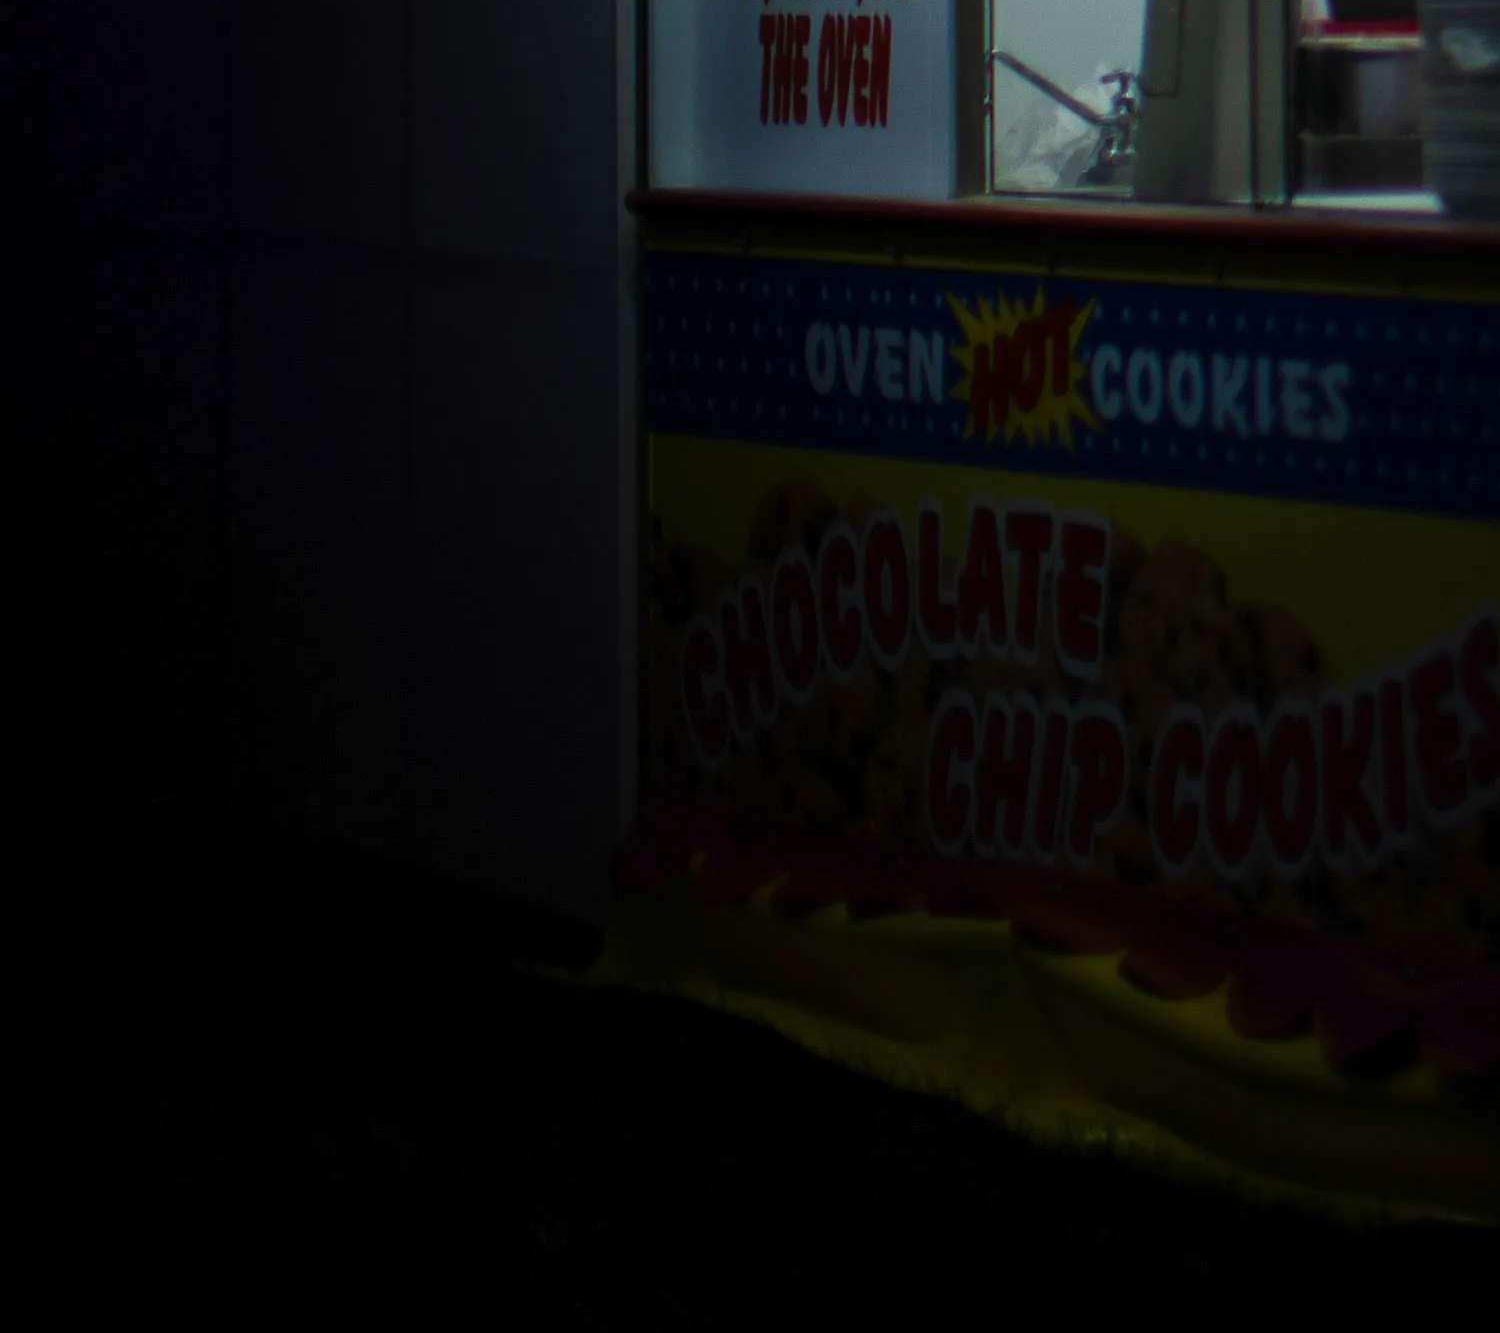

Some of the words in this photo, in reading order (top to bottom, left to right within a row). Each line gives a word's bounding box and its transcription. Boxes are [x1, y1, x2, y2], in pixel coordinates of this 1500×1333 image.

[759, 13, 808, 126] THE
[818, 13, 892, 127] OVEN
[803, 319, 948, 406] OVEN
[969, 296, 1080, 435] HOT
[1090, 339, 1355, 446] COOKIES
[680, 493, 1115, 771] CHOCOLATE
[928, 688, 1130, 863] CHIP
